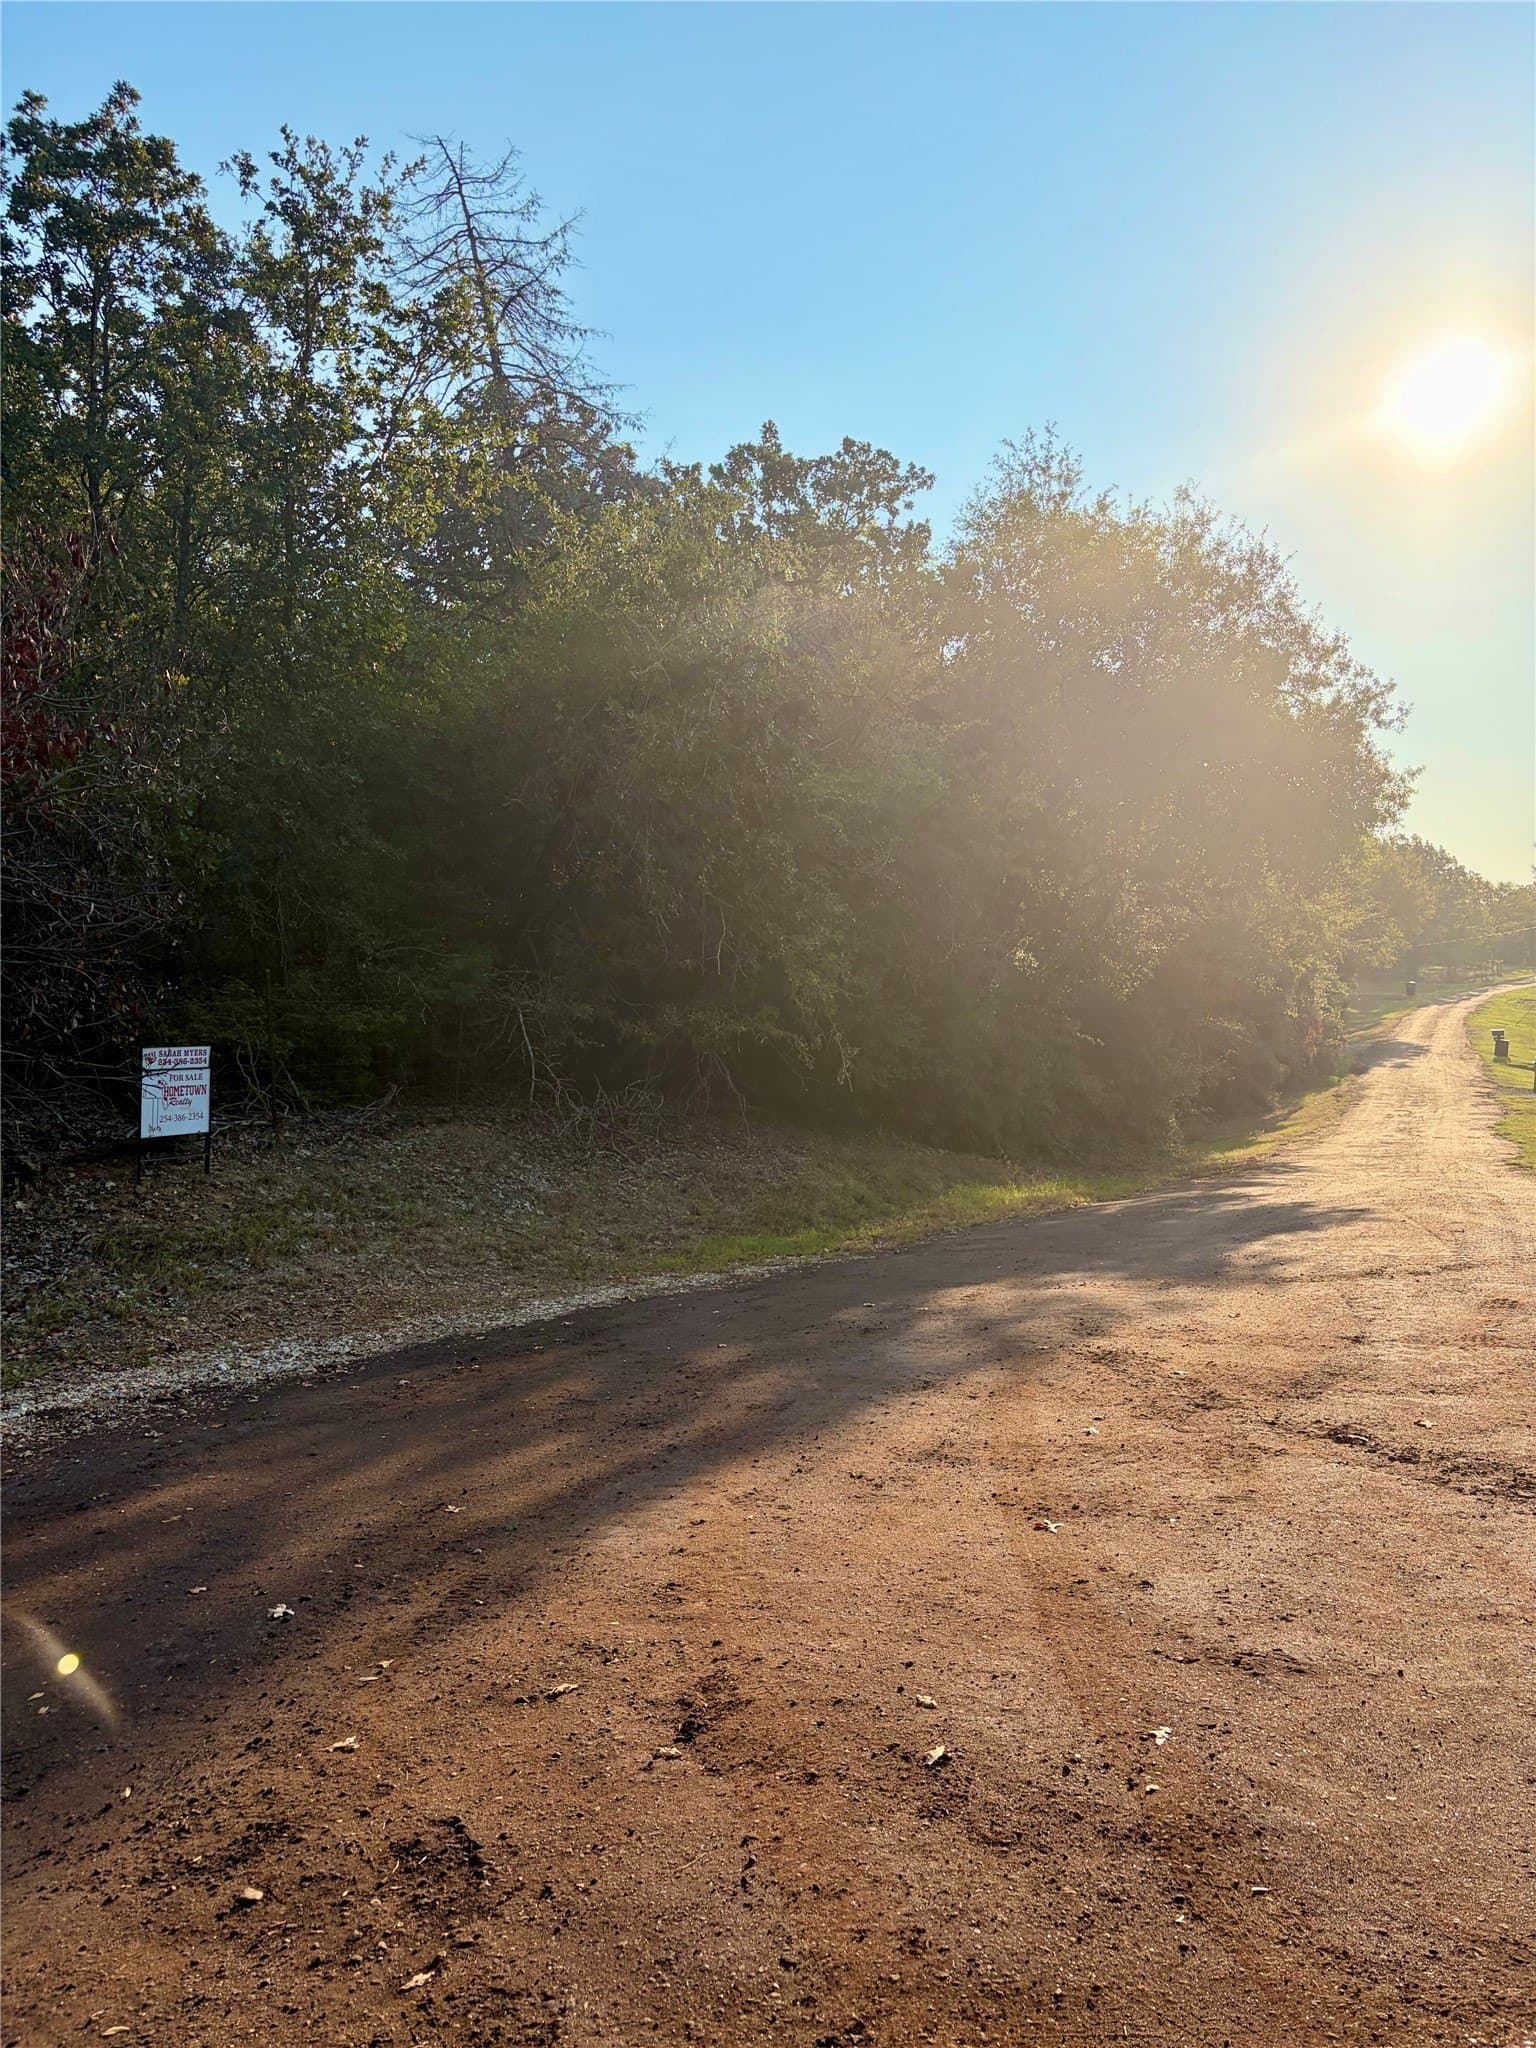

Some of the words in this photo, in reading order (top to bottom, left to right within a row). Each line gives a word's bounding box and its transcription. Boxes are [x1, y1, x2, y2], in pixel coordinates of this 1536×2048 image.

[158, 1049, 181, 1057] SARAH
[169, 1074, 183, 1082] FOR
[185, 1073, 203, 1081] SALE
[164, 1084, 207, 1097] HOMETOWN
[168, 1097, 192, 1106] Realty
[159, 1112, 204, 1123] 254-386-2354
